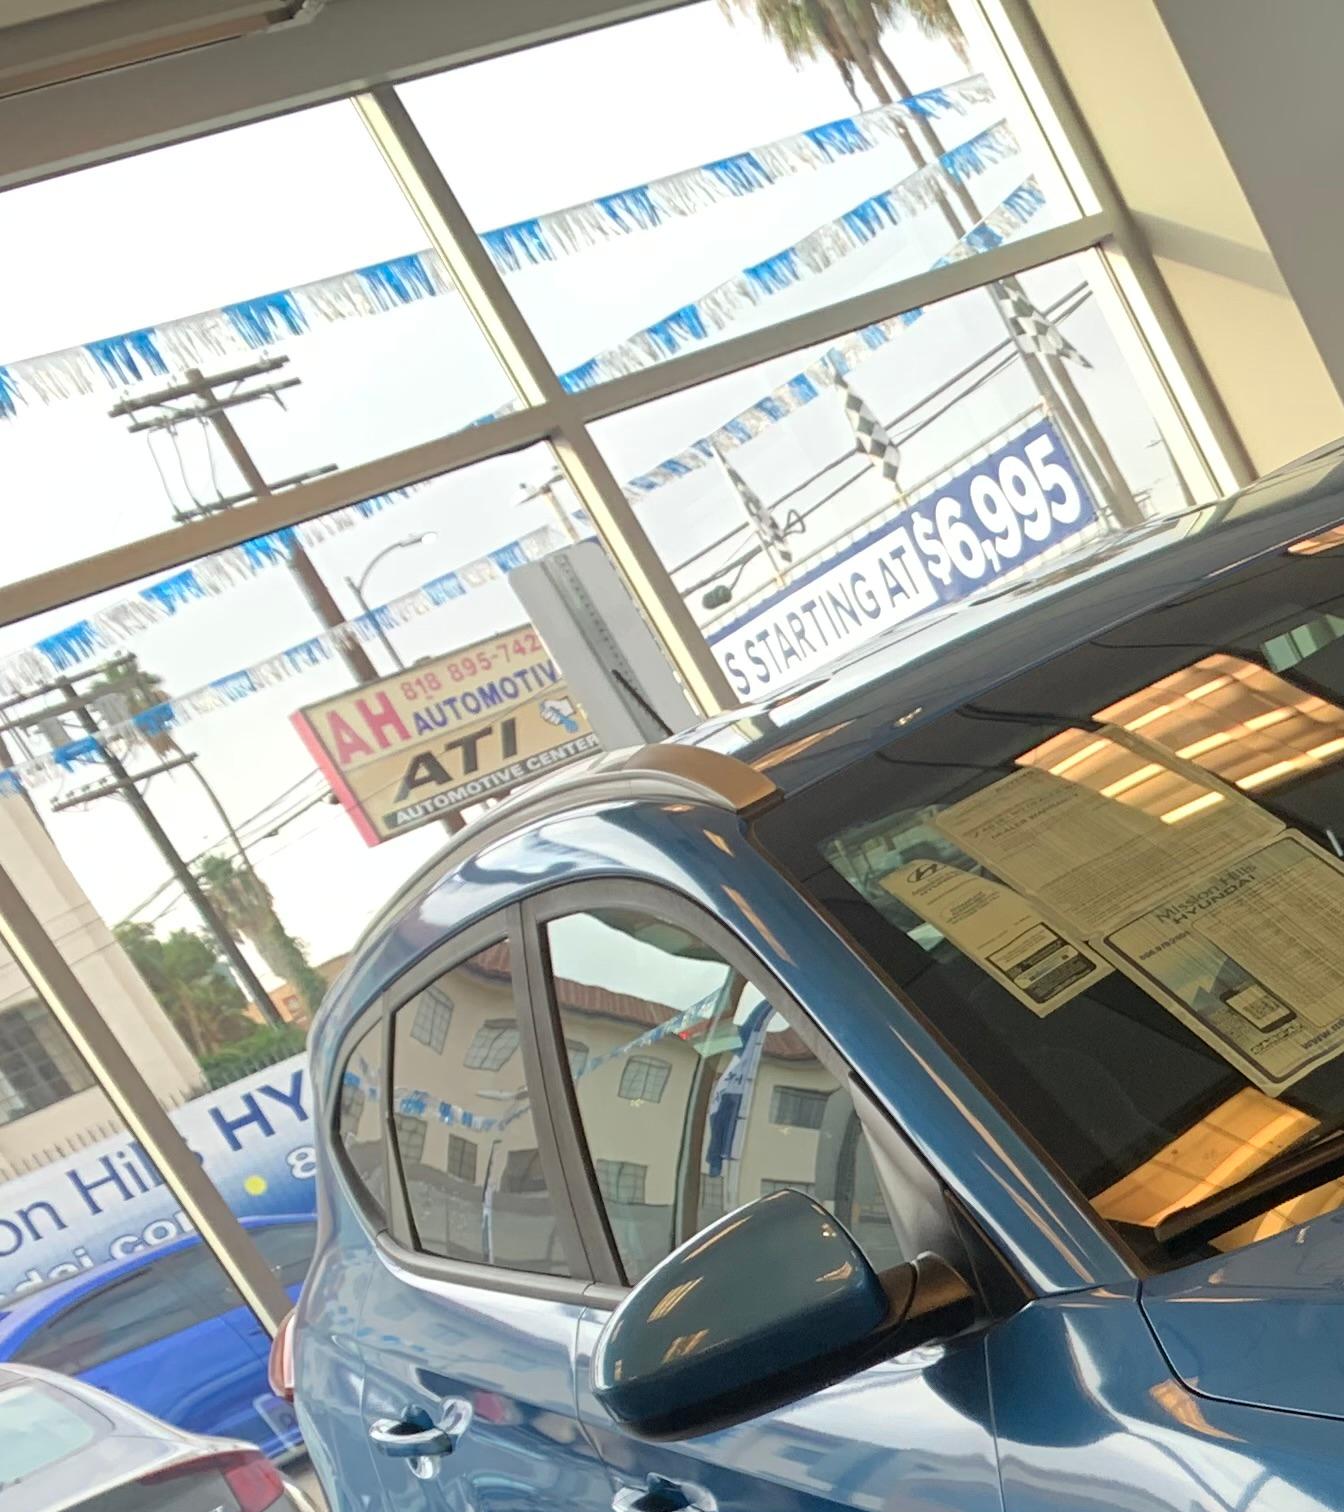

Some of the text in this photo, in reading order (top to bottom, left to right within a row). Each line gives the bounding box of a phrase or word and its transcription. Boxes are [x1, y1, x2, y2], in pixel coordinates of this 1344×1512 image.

[744, 571, 882, 683] STARTING
[877, 544, 921, 609] AT
[912, 433, 1082, 586] $6,995
[400, 634, 543, 701] 818 895-742
[325, 659, 558, 765] AH AUTOMOTIV
[392, 716, 518, 804] ATI
[396, 734, 599, 825] AUTOMOTIVE CENTER
[1172, 874, 1257, 925] HYUNDAI
[65, 1140, 166, 1216] Hil
